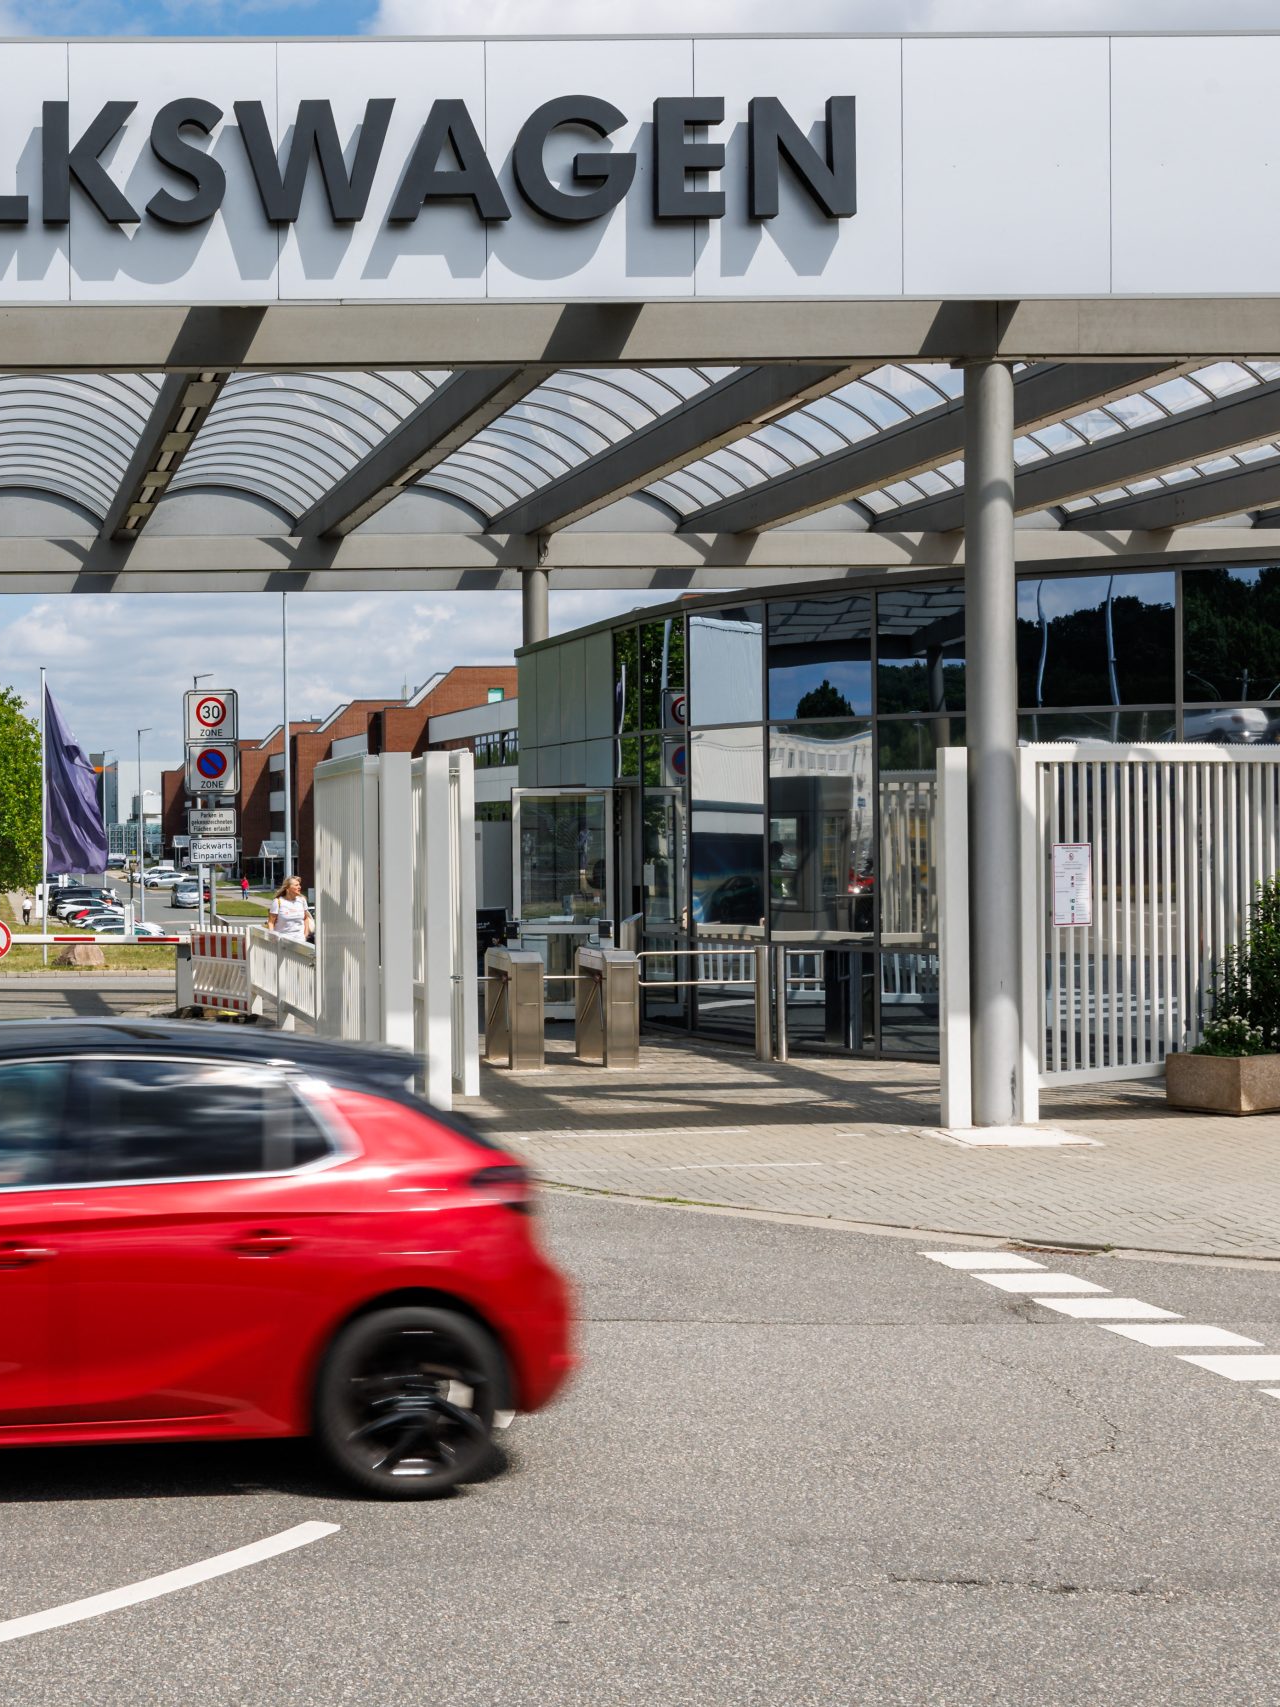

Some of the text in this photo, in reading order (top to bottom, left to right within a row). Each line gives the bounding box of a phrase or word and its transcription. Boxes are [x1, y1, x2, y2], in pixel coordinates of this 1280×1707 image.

[202, 705, 220, 719] 30
[200, 728, 223, 737] ZONE
[201, 780, 224, 789] ZONE
[192, 842, 233, 850] Rückwärts
[193, 852, 232, 861] Einparken
